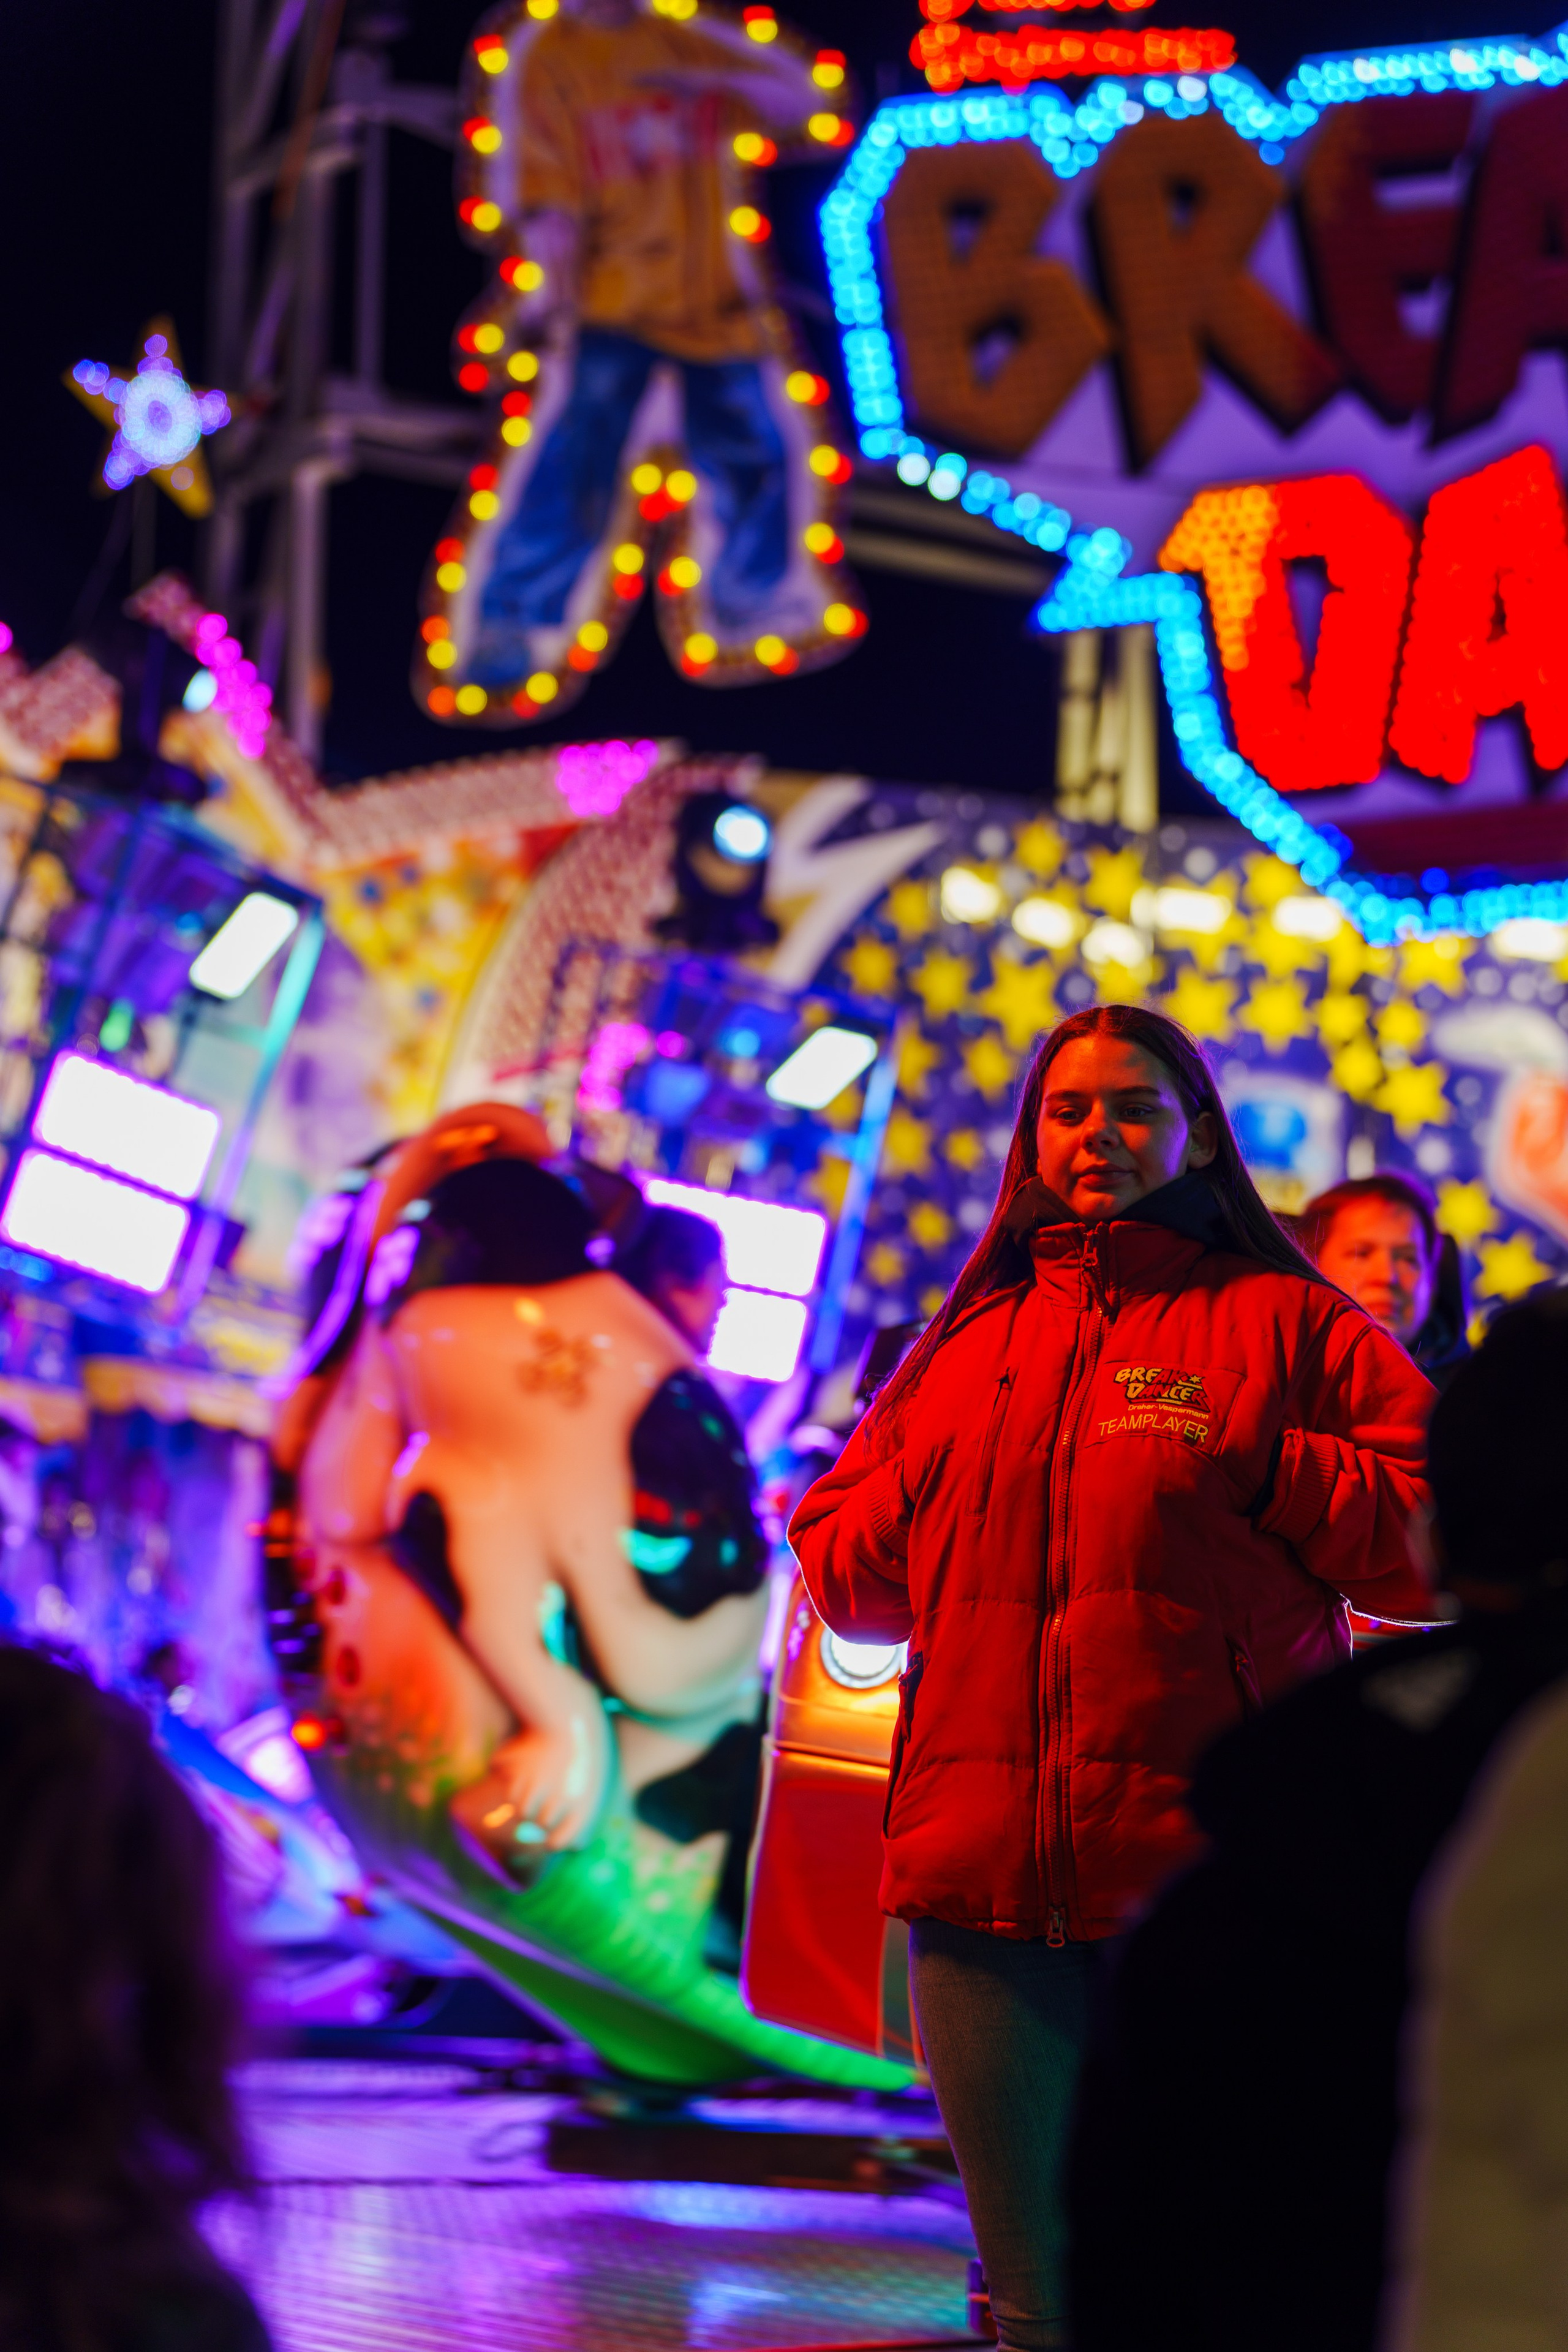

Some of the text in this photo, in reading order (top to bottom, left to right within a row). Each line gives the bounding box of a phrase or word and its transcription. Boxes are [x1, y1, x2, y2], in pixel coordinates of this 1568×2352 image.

[1114, 1366, 1188, 1384] BREAK
[1126, 1382, 1210, 1411] DANCER
[1128, 1403, 1209, 1420] Dreher-Vespermann
[1098, 1414, 1208, 1443] TEAMPLAYER
